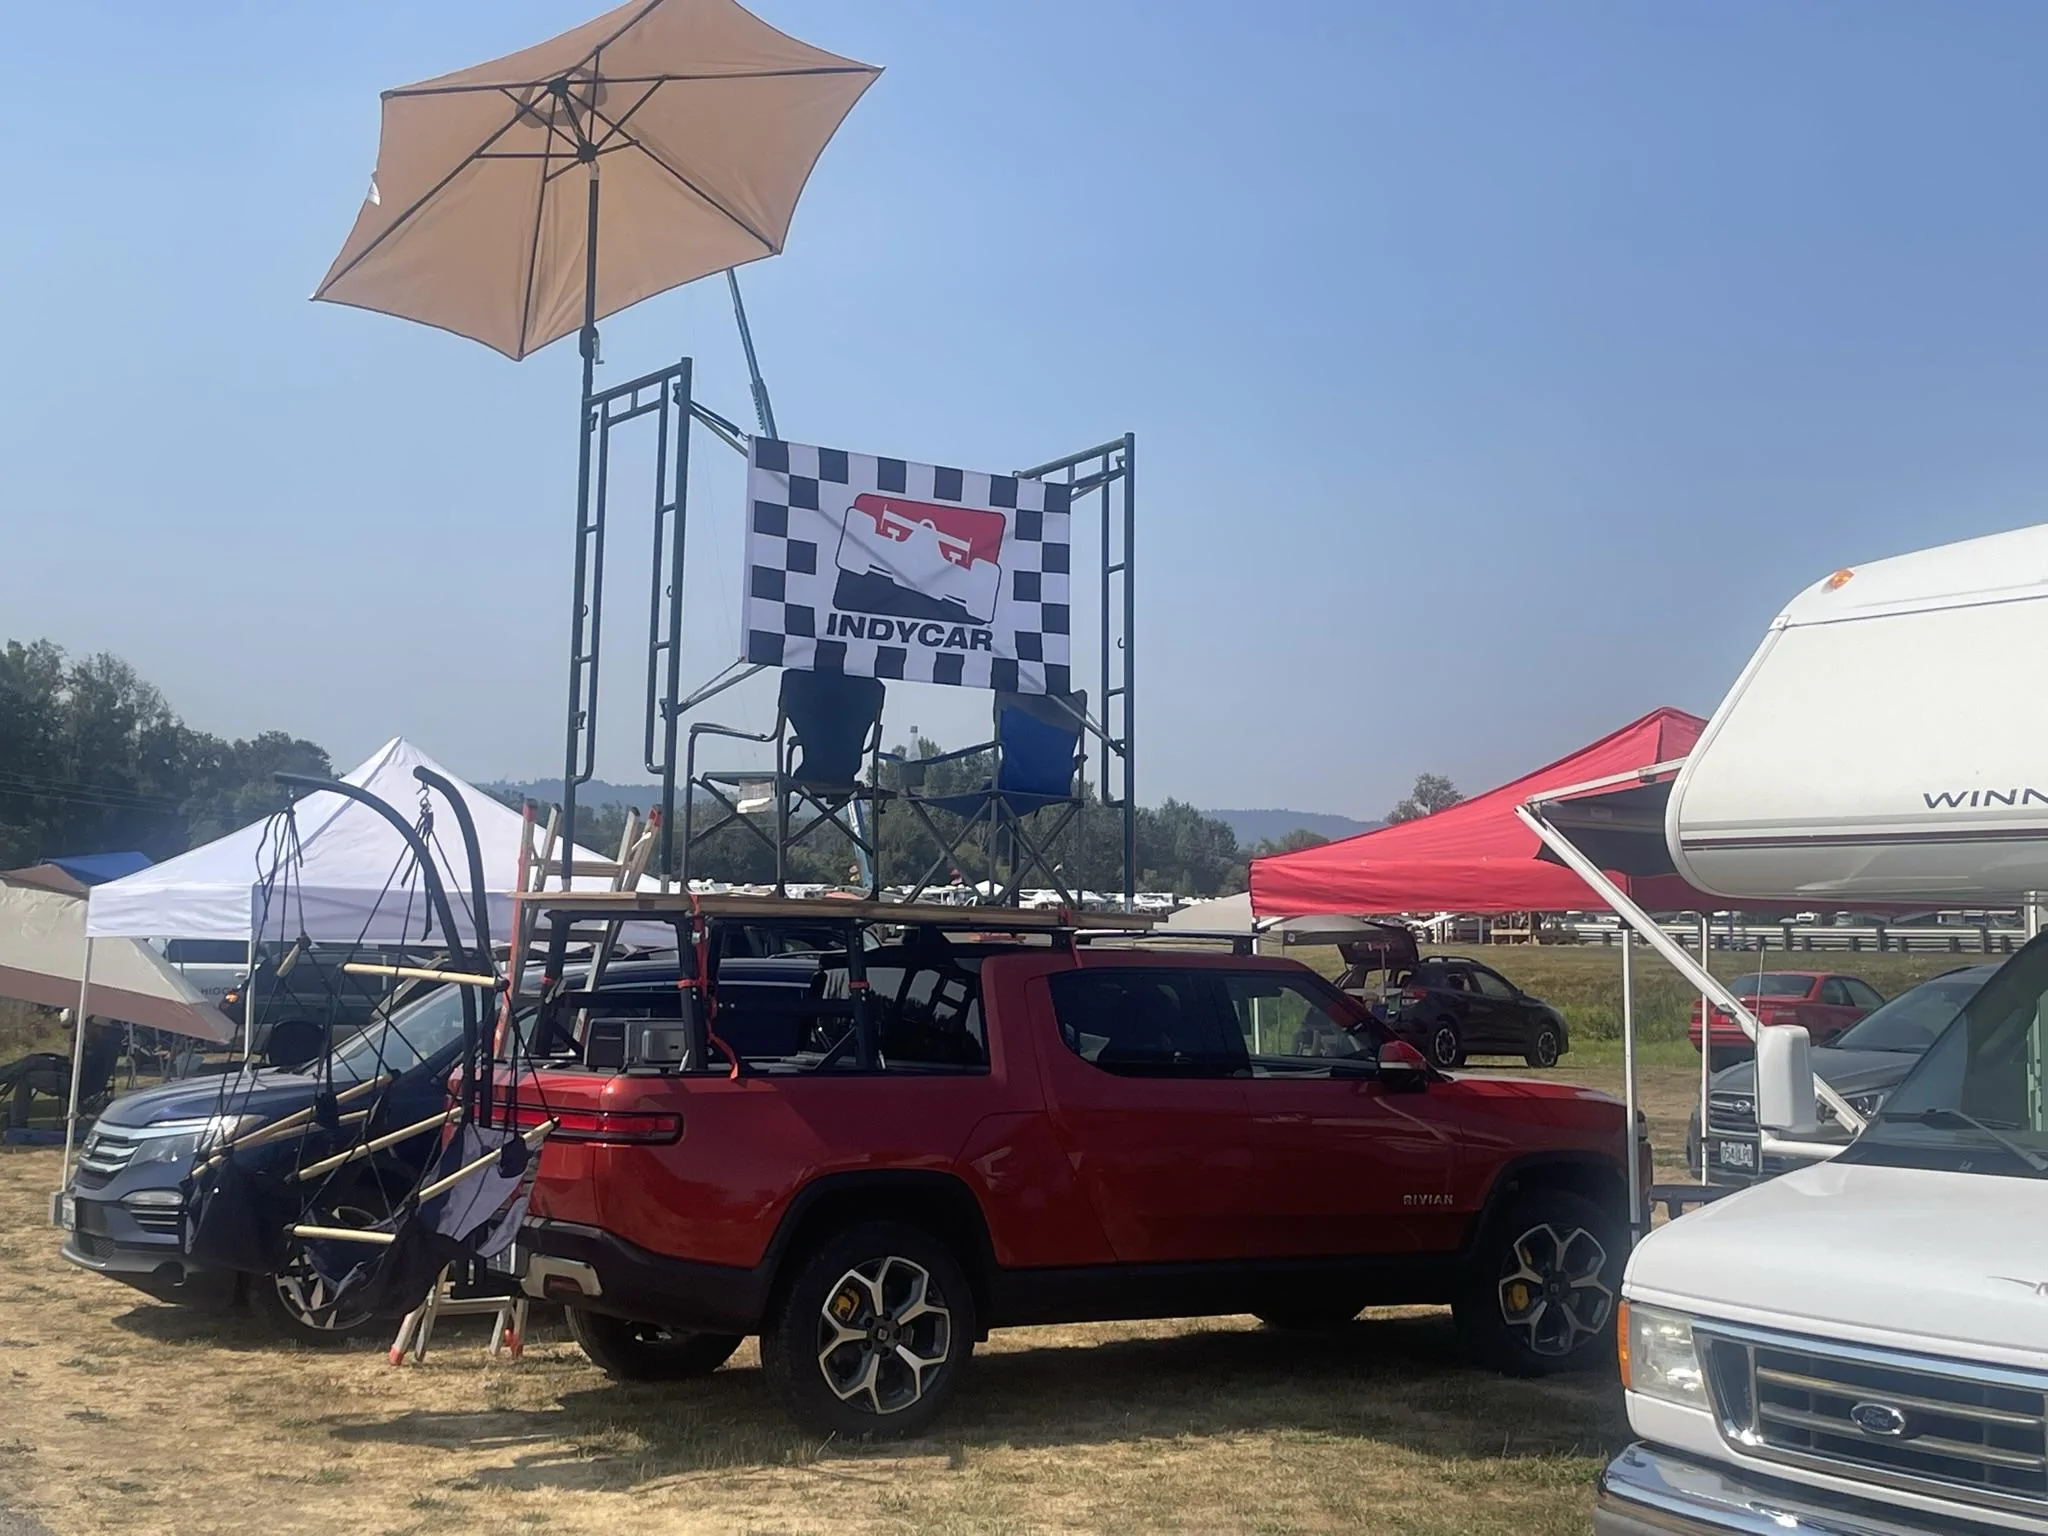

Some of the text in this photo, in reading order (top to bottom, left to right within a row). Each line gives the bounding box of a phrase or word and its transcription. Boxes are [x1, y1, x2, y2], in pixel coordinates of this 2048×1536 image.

[826, 612, 993, 651] INDYCAR
[1923, 788, 2048, 809] WINN
[1403, 1194, 1454, 1205] RIVIAN
